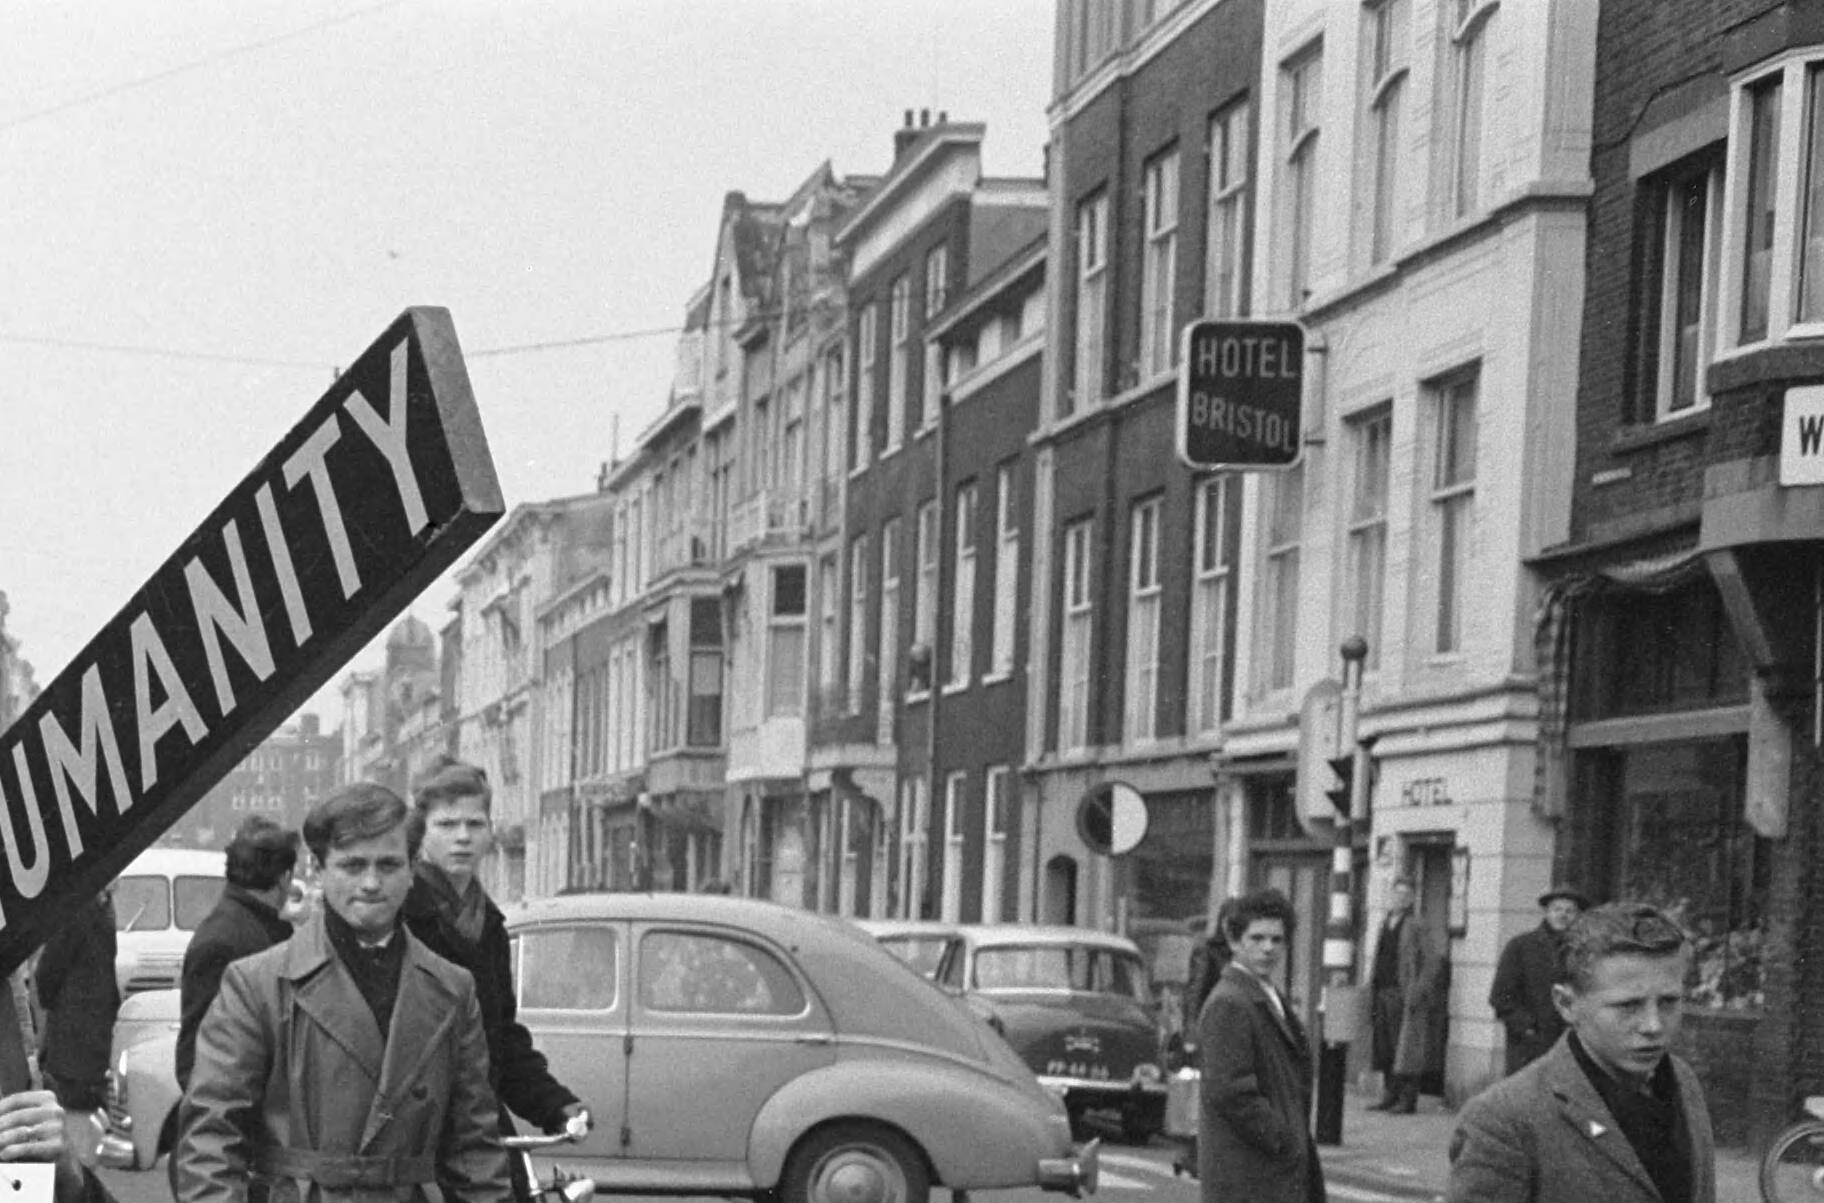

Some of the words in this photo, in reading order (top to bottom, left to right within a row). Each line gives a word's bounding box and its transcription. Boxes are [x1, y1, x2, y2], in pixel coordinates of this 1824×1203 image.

[1197, 337, 1297, 378] HOTEL
[1191, 391, 1296, 453] BRISTOL
[1400, 778, 1453, 808] HOTEL
